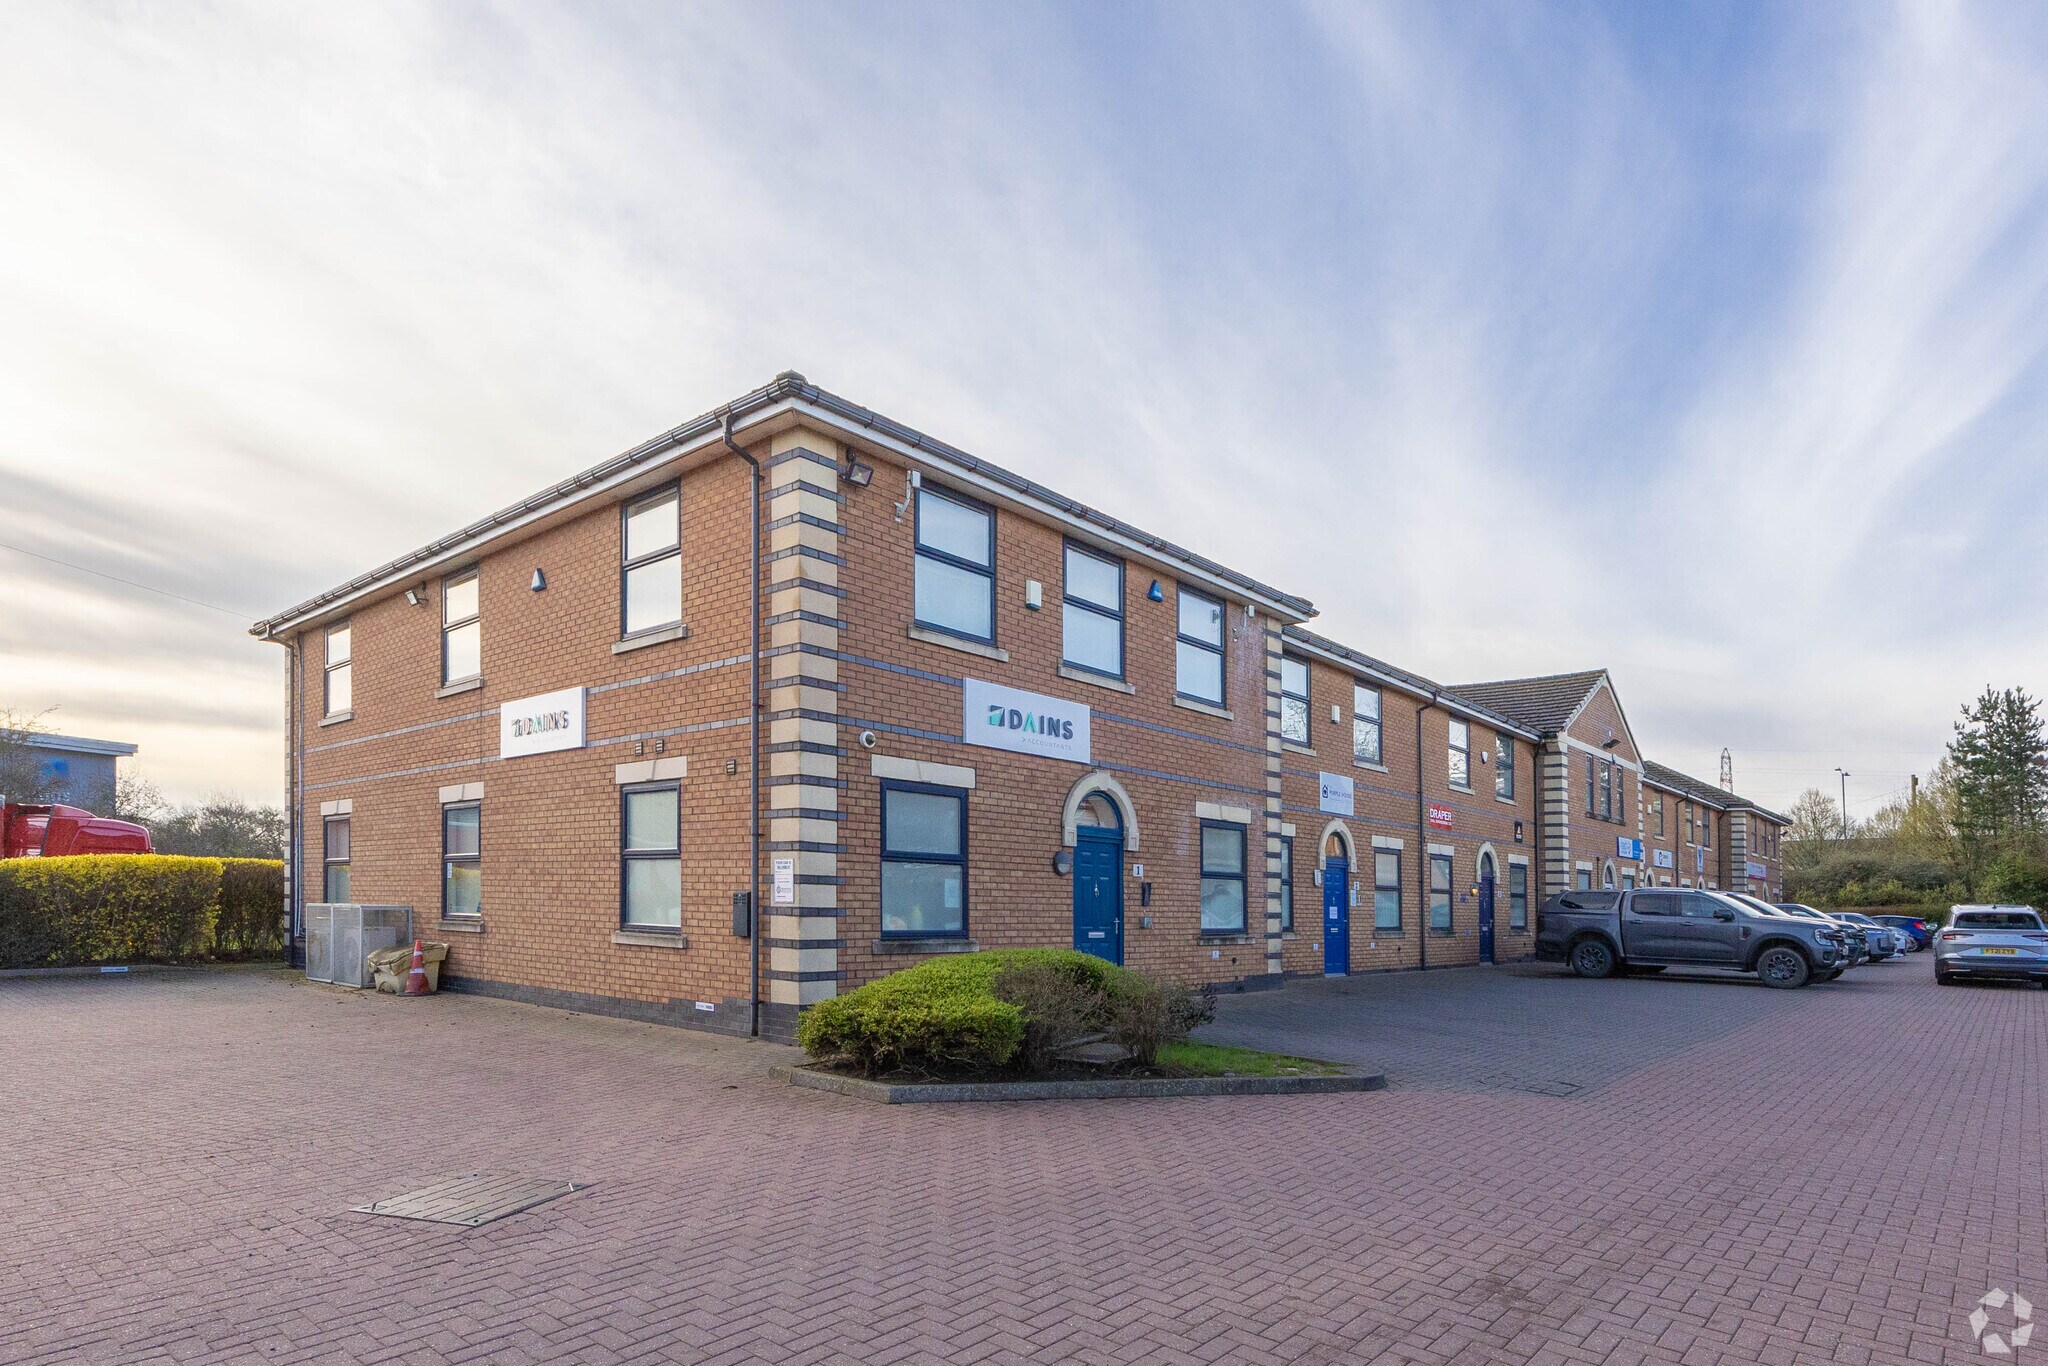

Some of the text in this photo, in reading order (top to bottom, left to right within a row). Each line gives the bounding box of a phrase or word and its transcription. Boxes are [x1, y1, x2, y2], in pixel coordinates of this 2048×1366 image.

[523, 709, 569, 735] DAINS
[1009, 708, 1073, 739] DAINS
[1027, 738, 1072, 751] ACCOUNTANTS
[1429, 808, 1452, 821] DRAPER
[1136, 865, 1140, 875] 1
